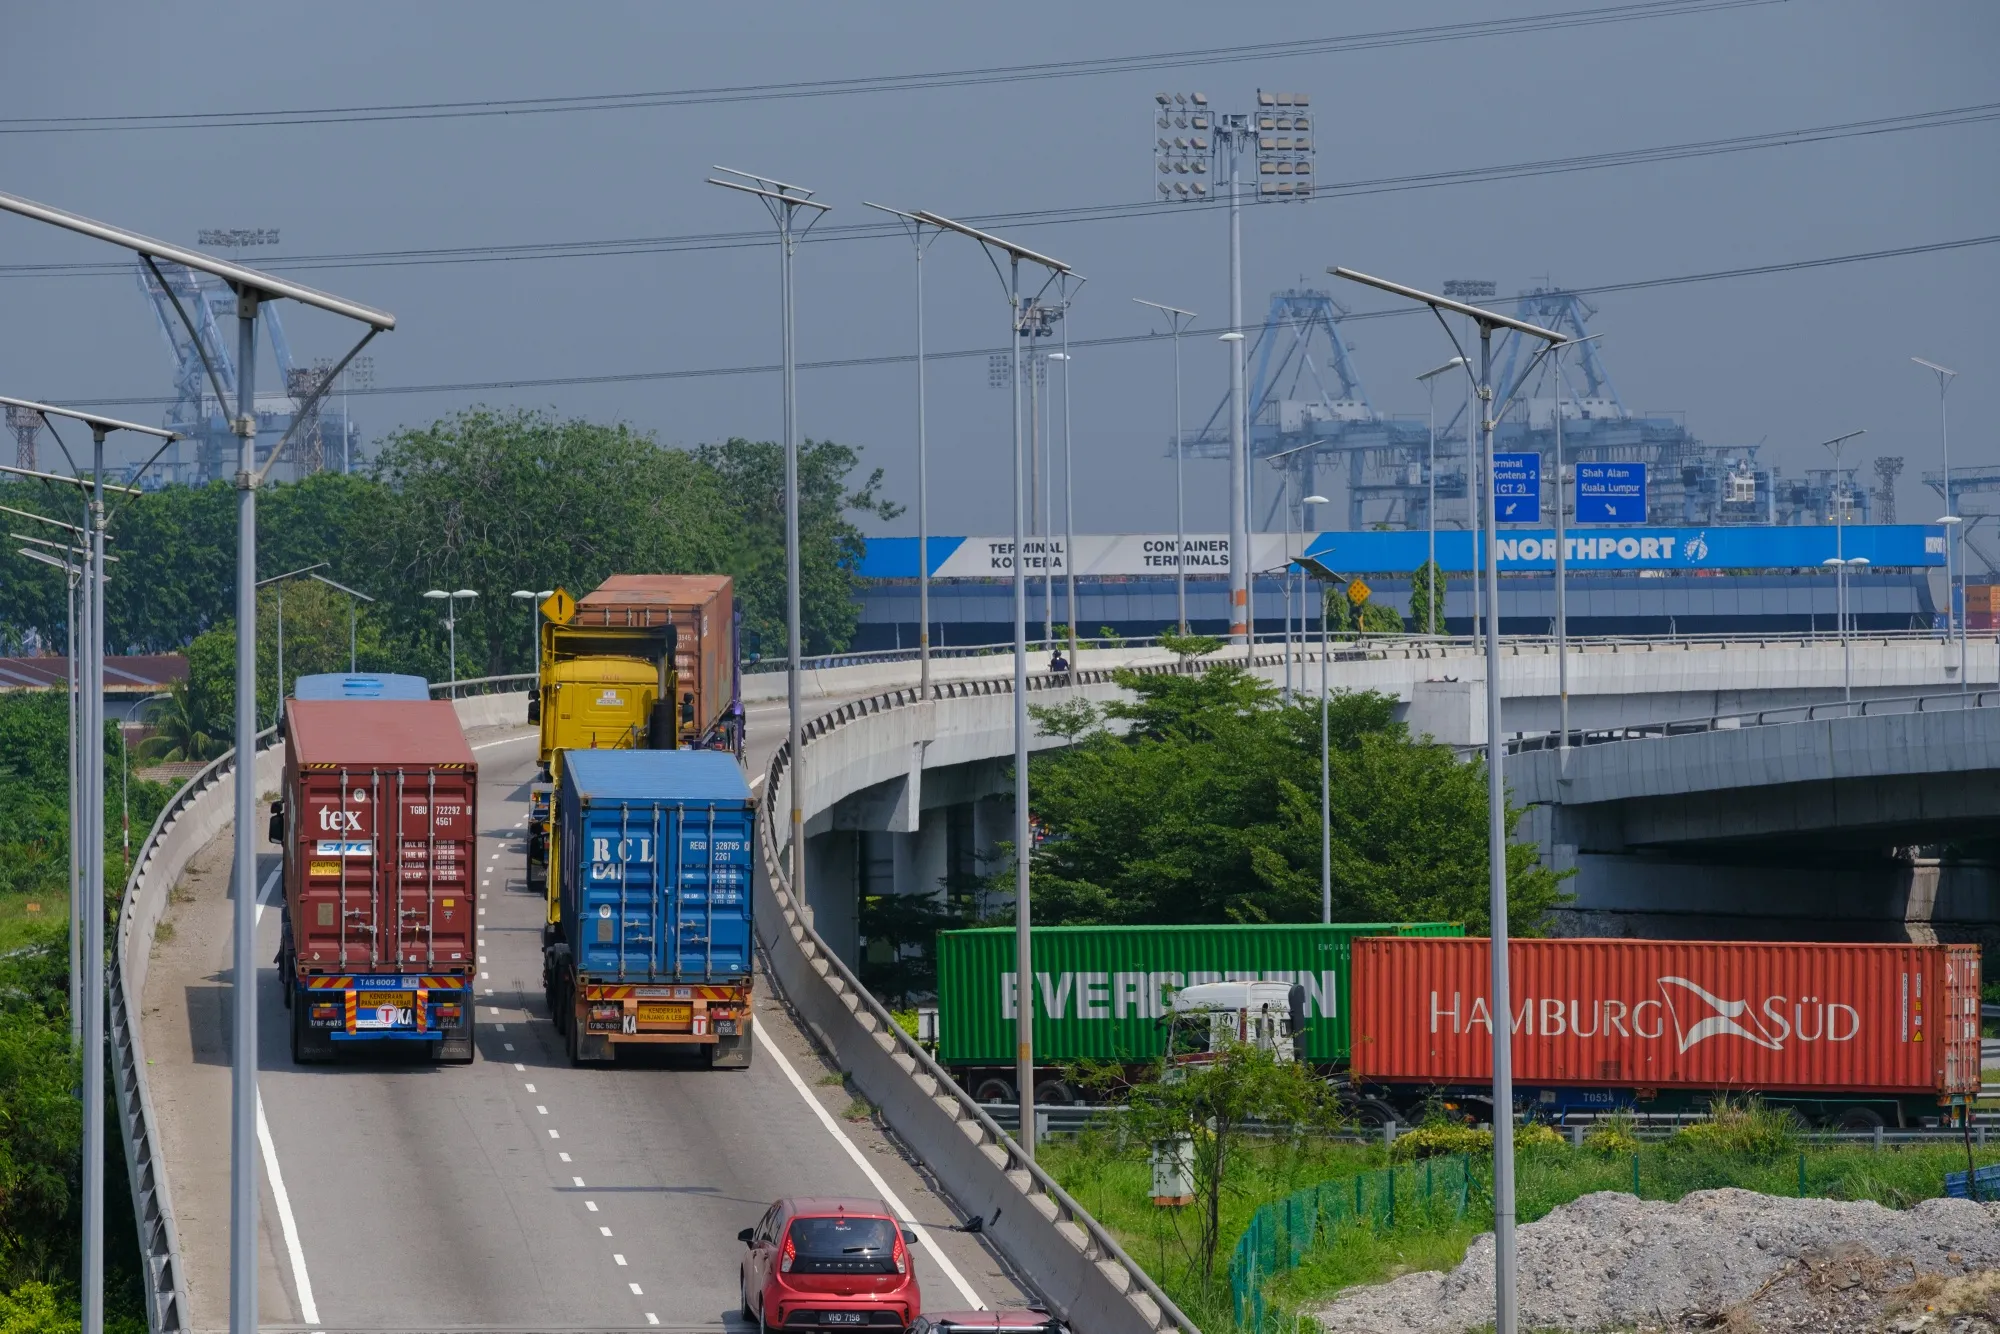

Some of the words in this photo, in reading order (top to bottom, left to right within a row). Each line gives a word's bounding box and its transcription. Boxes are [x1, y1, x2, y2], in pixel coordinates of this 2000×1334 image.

[1493, 458, 1523, 468] erminal
[1494, 470, 1526, 480] Kontena
[1530, 470, 1536, 480] 2
[1582, 468, 1604, 478] Shah
[1607, 469, 1629, 478] Alam
[1496, 482, 1513, 494] (CT
[1516, 482, 1526, 494] 2)
[1582, 483, 1606, 492] Kuala
[1608, 484, 1640, 494] Lumpur
[1496, 538, 1676, 560] NORTHPORT
[410, 806, 427, 814] TGBU
[436, 806, 460, 814] 722292
[466, 806, 472, 815] 0
[436, 817, 452, 826] 45G1
[318, 843, 372, 852] SITC
[690, 841, 706, 850] REGU
[716, 842, 740, 850] 328785
[715, 852, 730, 861] 22G1
[381, 1009, 393, 1022] T
[398, 1009, 412, 1024] KA
[1430, 991, 1663, 1038] HAMBURG
[1764, 996, 1859, 1042] SÜD
[623, 1016, 636, 1033] KA
[1583, 1093, 1614, 1102] T0534
